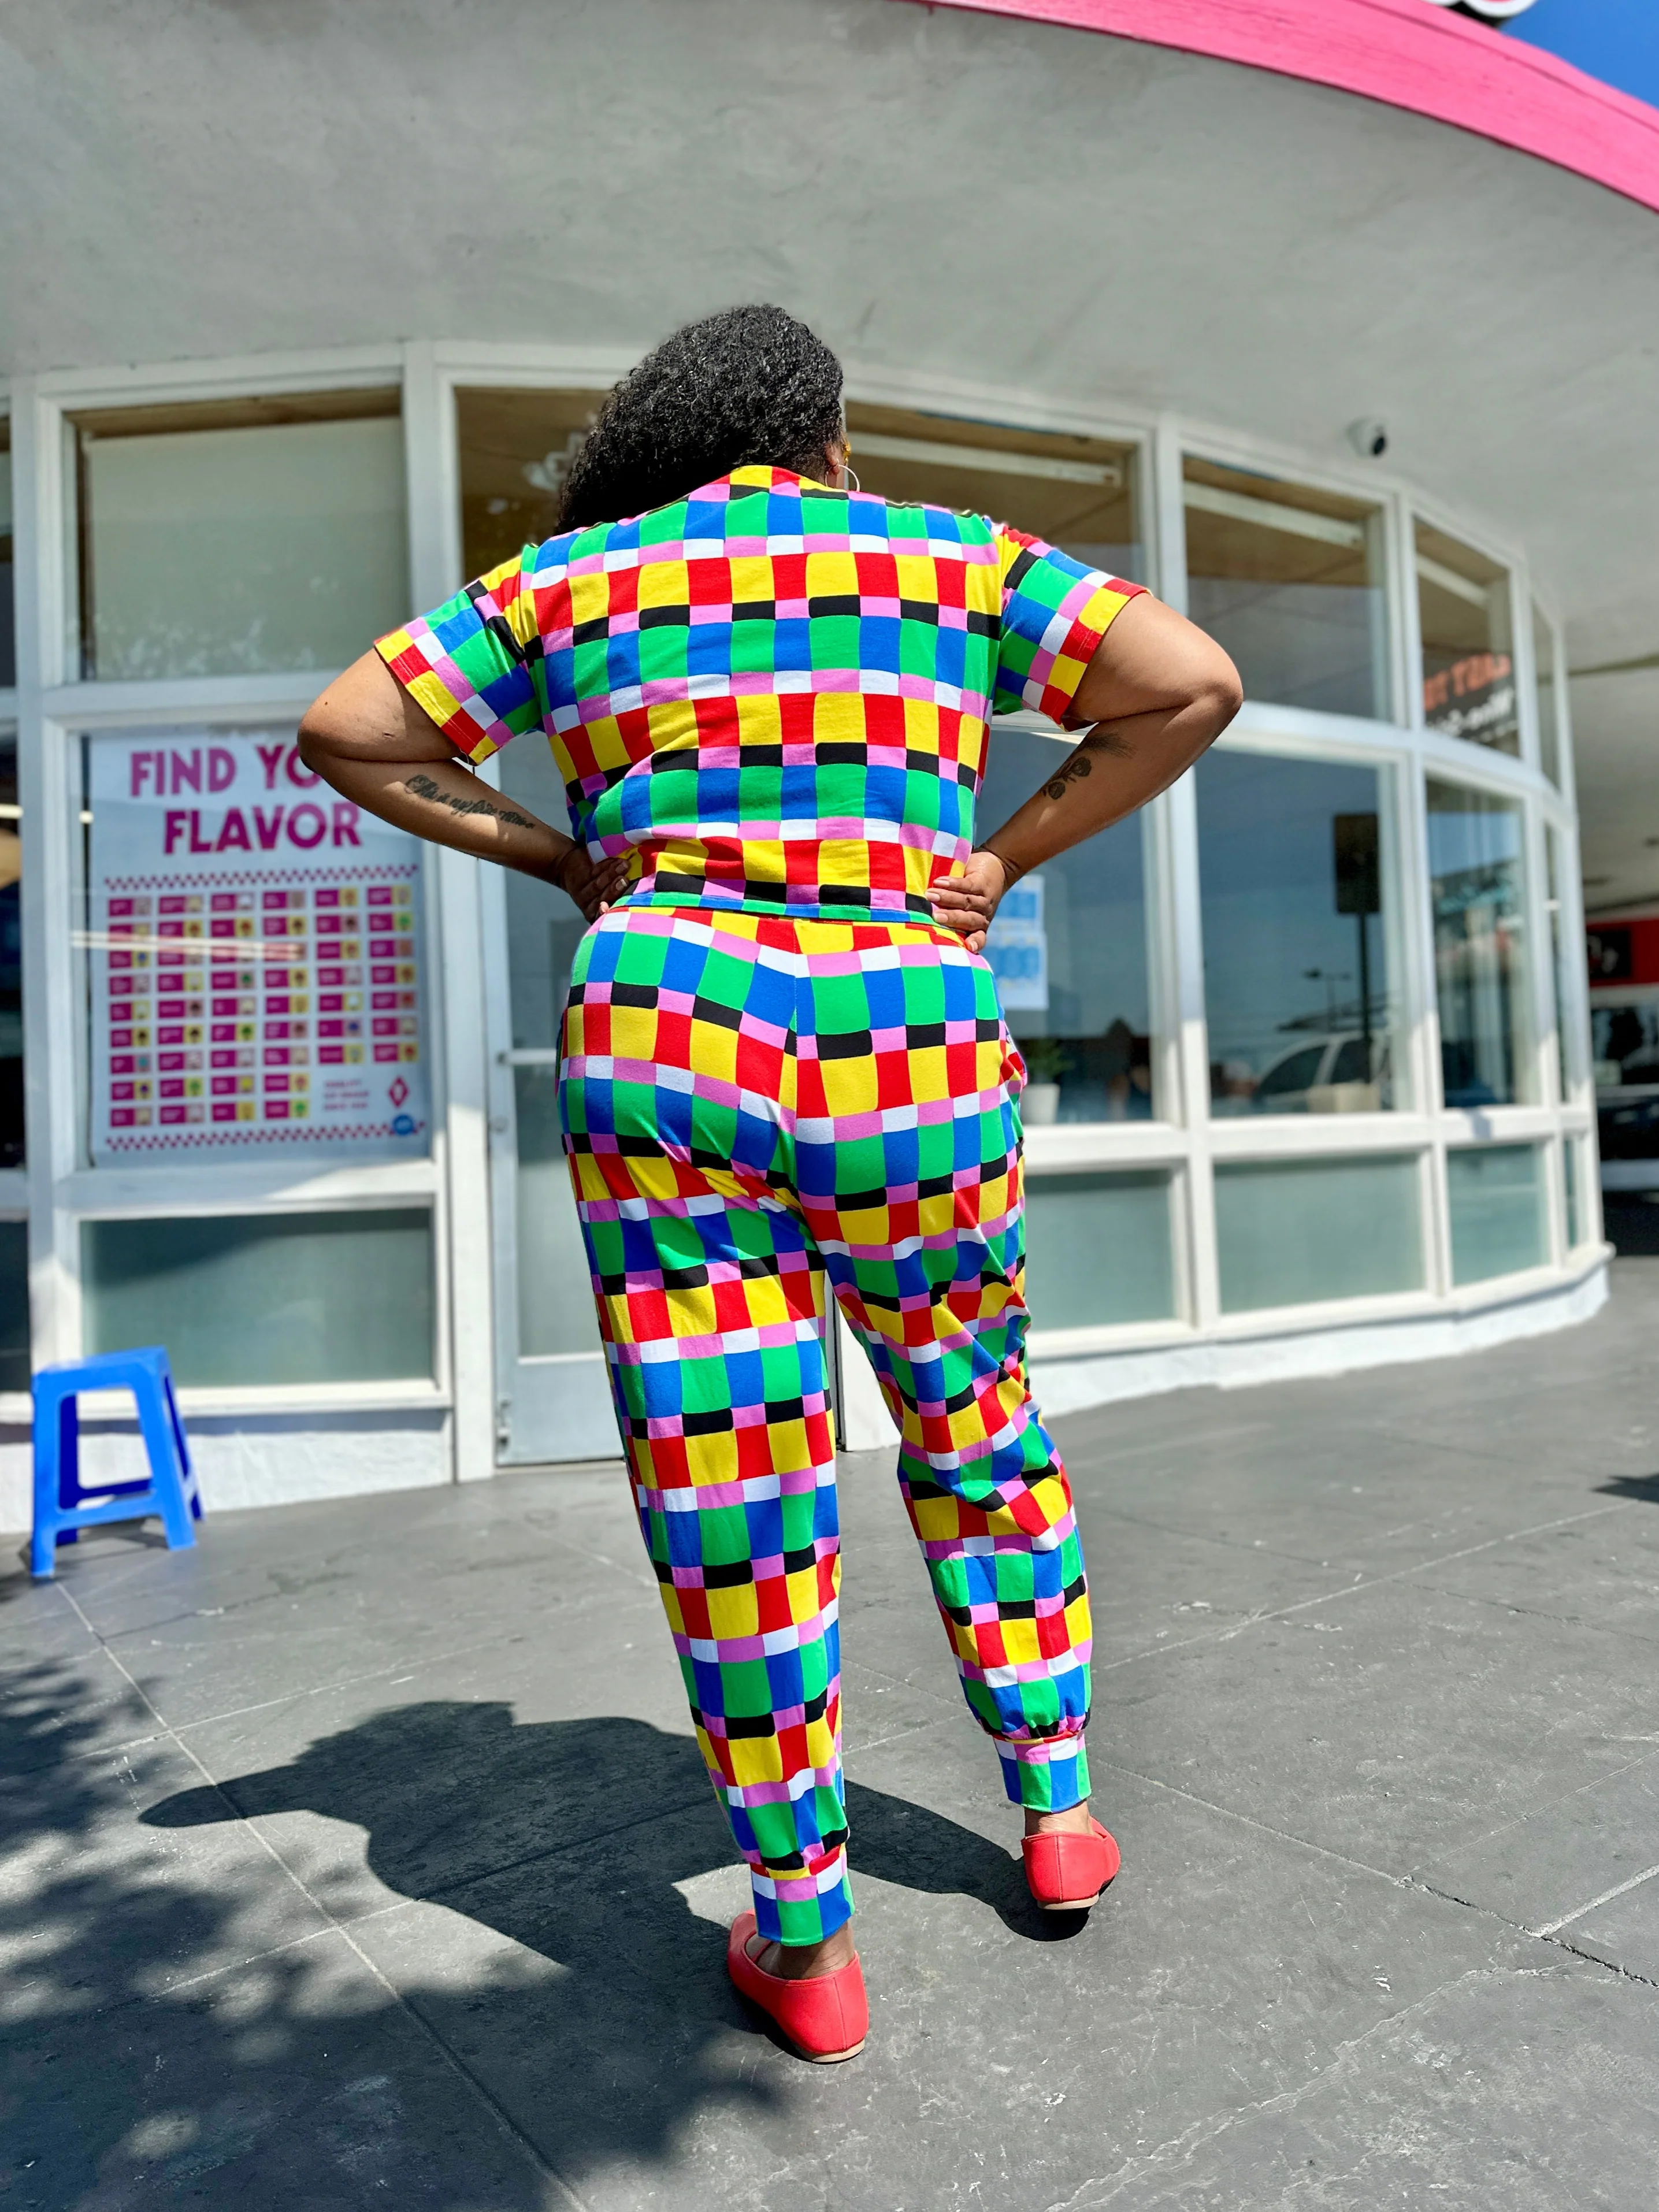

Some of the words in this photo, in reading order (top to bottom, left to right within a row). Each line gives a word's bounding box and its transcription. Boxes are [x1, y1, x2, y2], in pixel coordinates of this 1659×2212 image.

[130, 747, 237, 797] FIND
[254, 743, 324, 789] YO
[164, 801, 362, 855] FLAVOR
